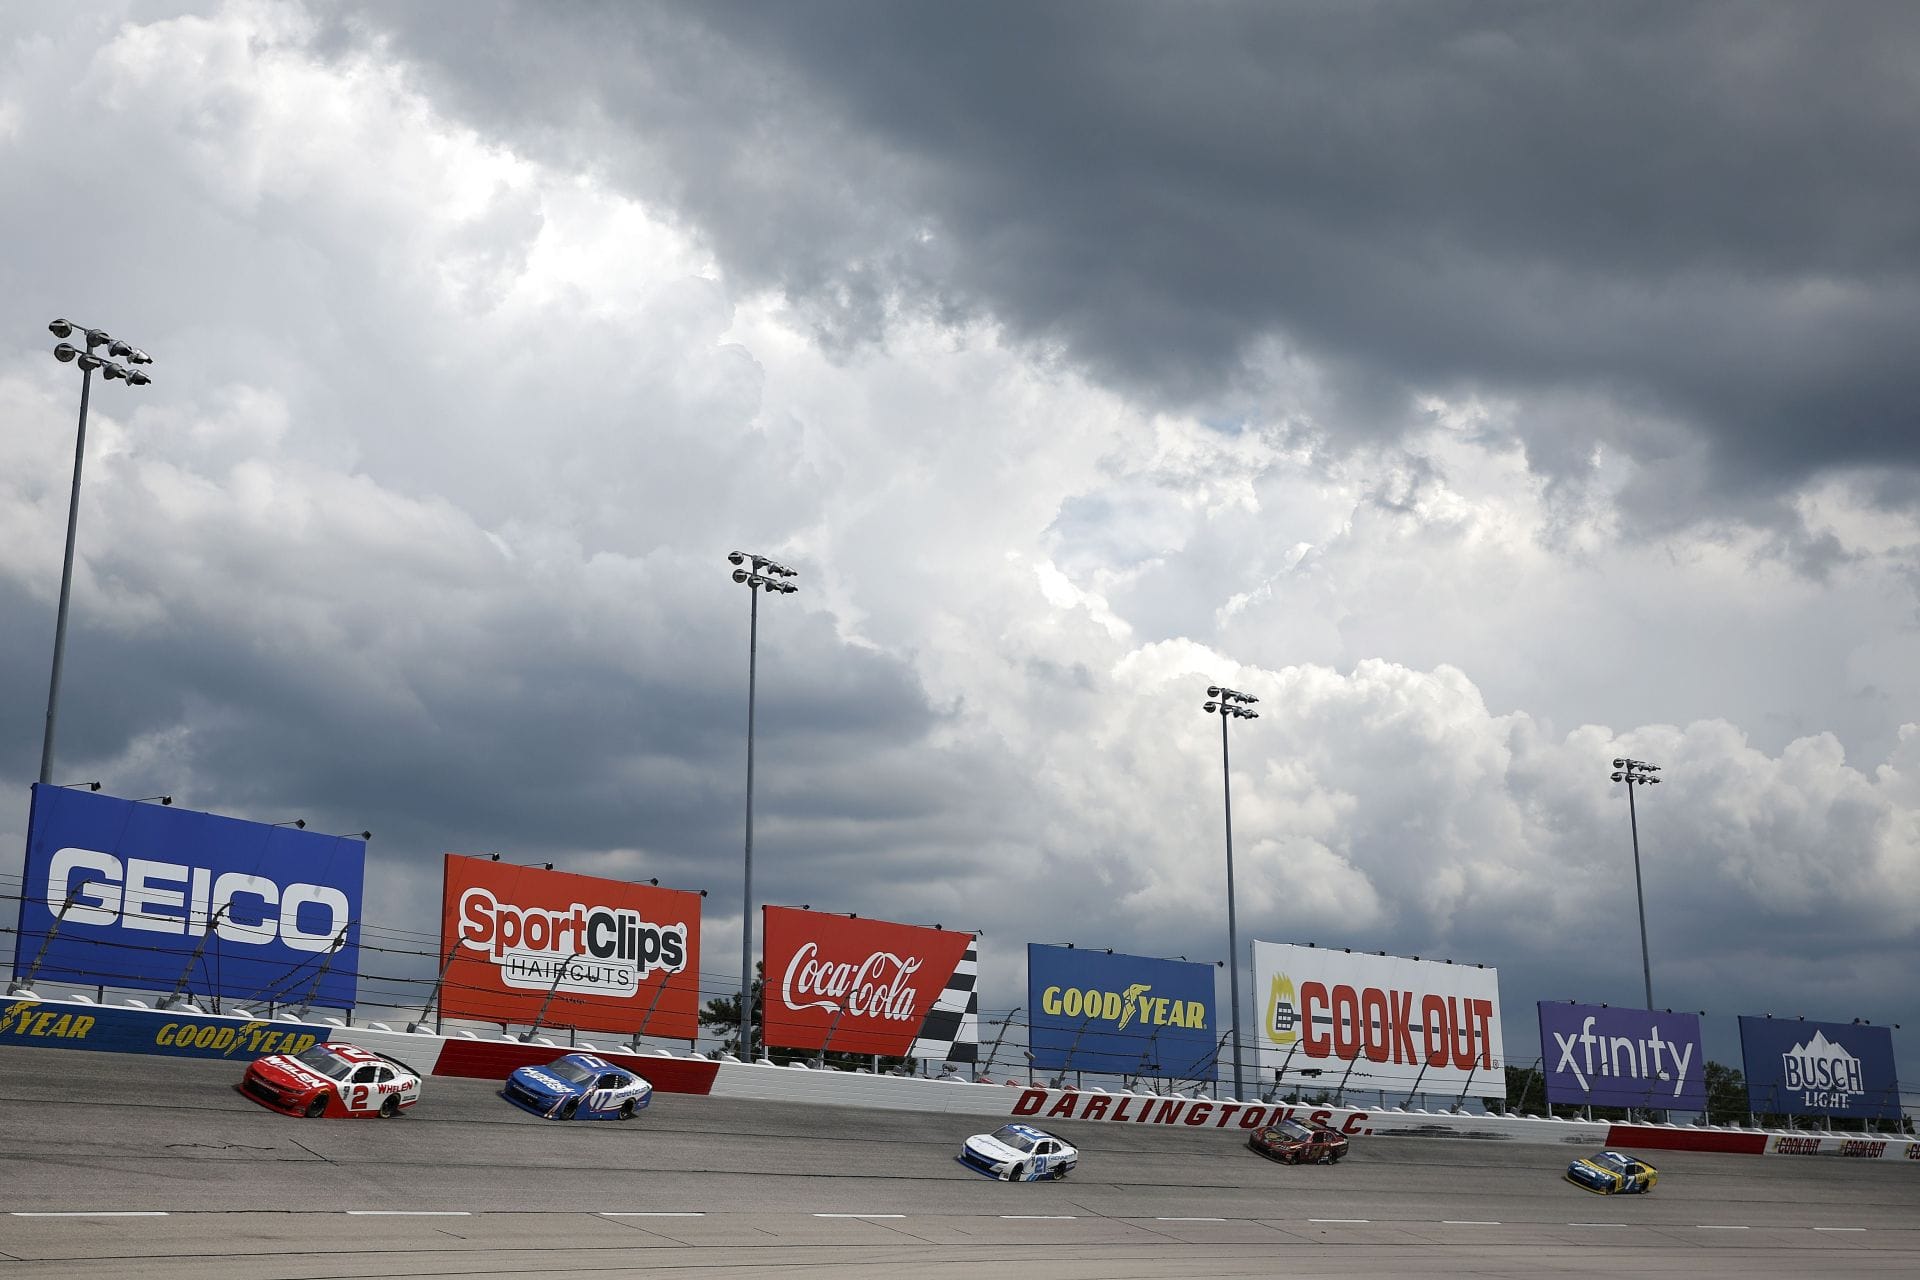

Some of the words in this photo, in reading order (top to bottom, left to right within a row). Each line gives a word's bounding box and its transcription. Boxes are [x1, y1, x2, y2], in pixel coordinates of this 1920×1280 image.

[47, 847, 349, 953] GEICO
[511, 958, 630, 986] HAIRCUTS
[782, 942, 924, 1022] Coca-Cola
[1553, 1016, 1693, 1097] xfinity
[265, 1055, 329, 1089] WHELEN
[1783, 1055, 1863, 1092] BUSCH
[350, 1085, 370, 1110] 2
[377, 1079, 413, 1095] WHELEN
[1805, 1091, 1848, 1108] LIGHT
[591, 1091, 613, 1113] 17
[1011, 1089, 1296, 1129] DARLINGTON
[1309, 1110, 1373, 1136] SC.
[1034, 1156, 1047, 1174] 21
[1624, 1175, 1636, 1190] 7
